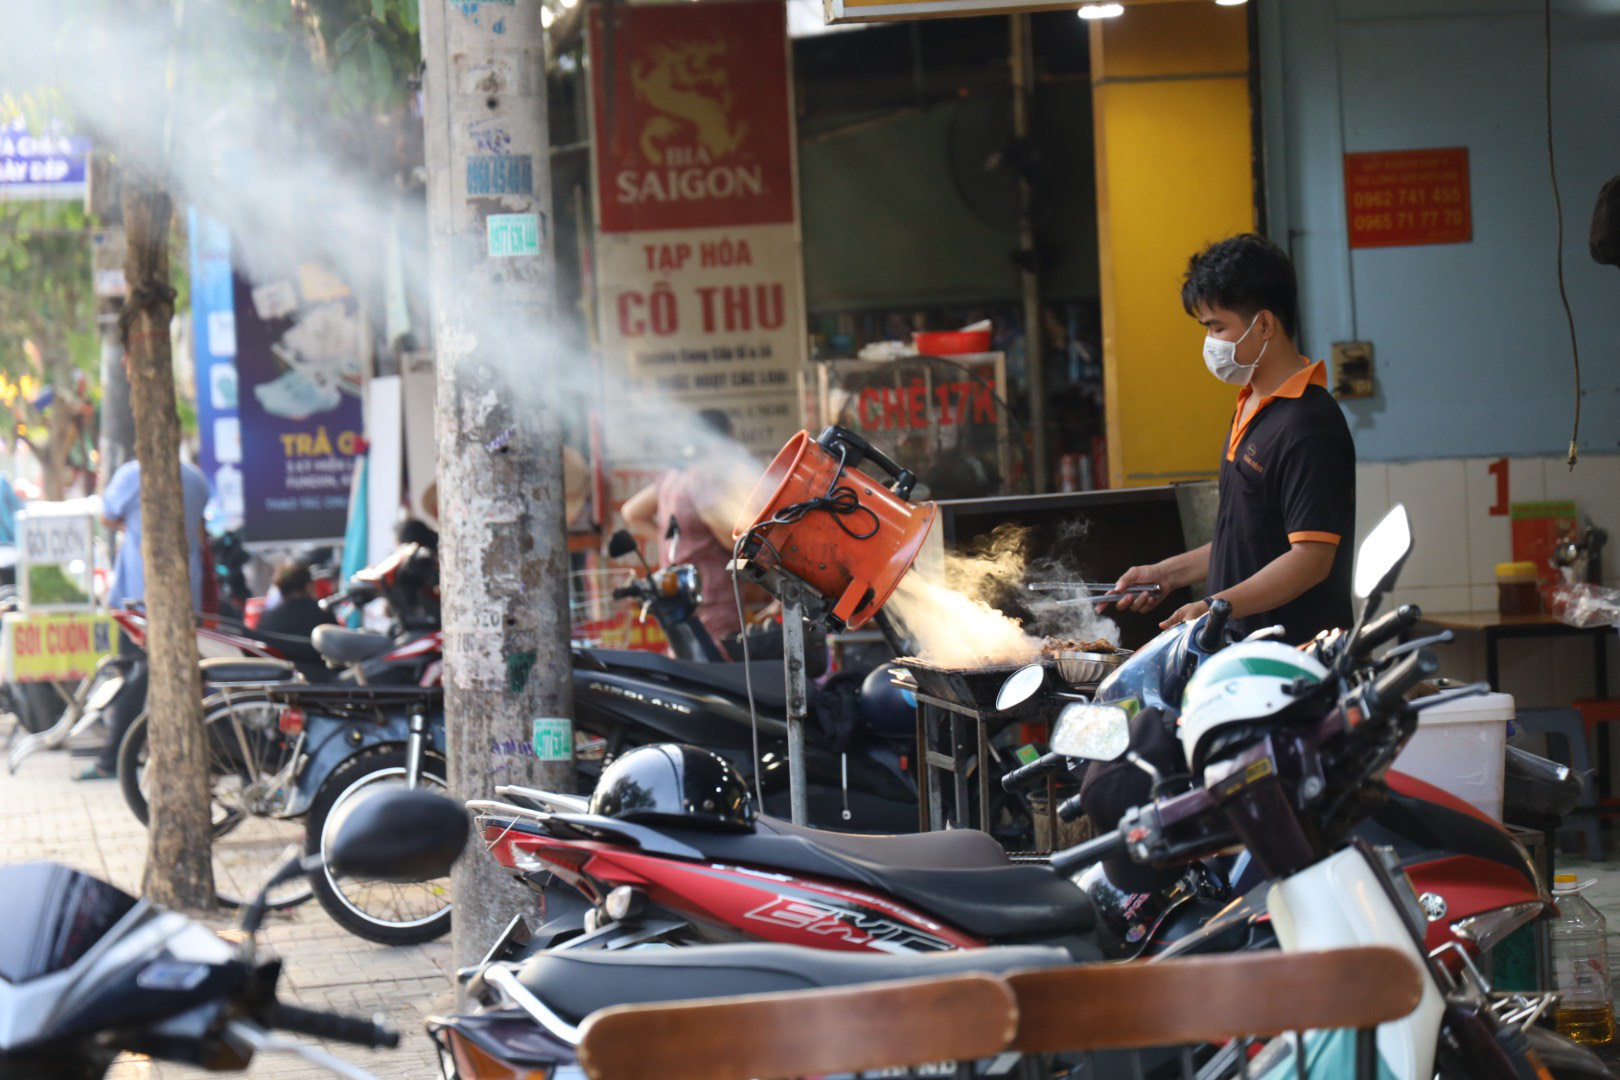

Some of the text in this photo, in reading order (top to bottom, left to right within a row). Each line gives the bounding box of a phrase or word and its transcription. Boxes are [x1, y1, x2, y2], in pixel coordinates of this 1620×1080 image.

[666, 146, 711, 167] BIA
[616, 165, 762, 203] SAIGON
[617, 281, 785, 338] CÔ THU
[1488, 458, 1509, 516] 1
